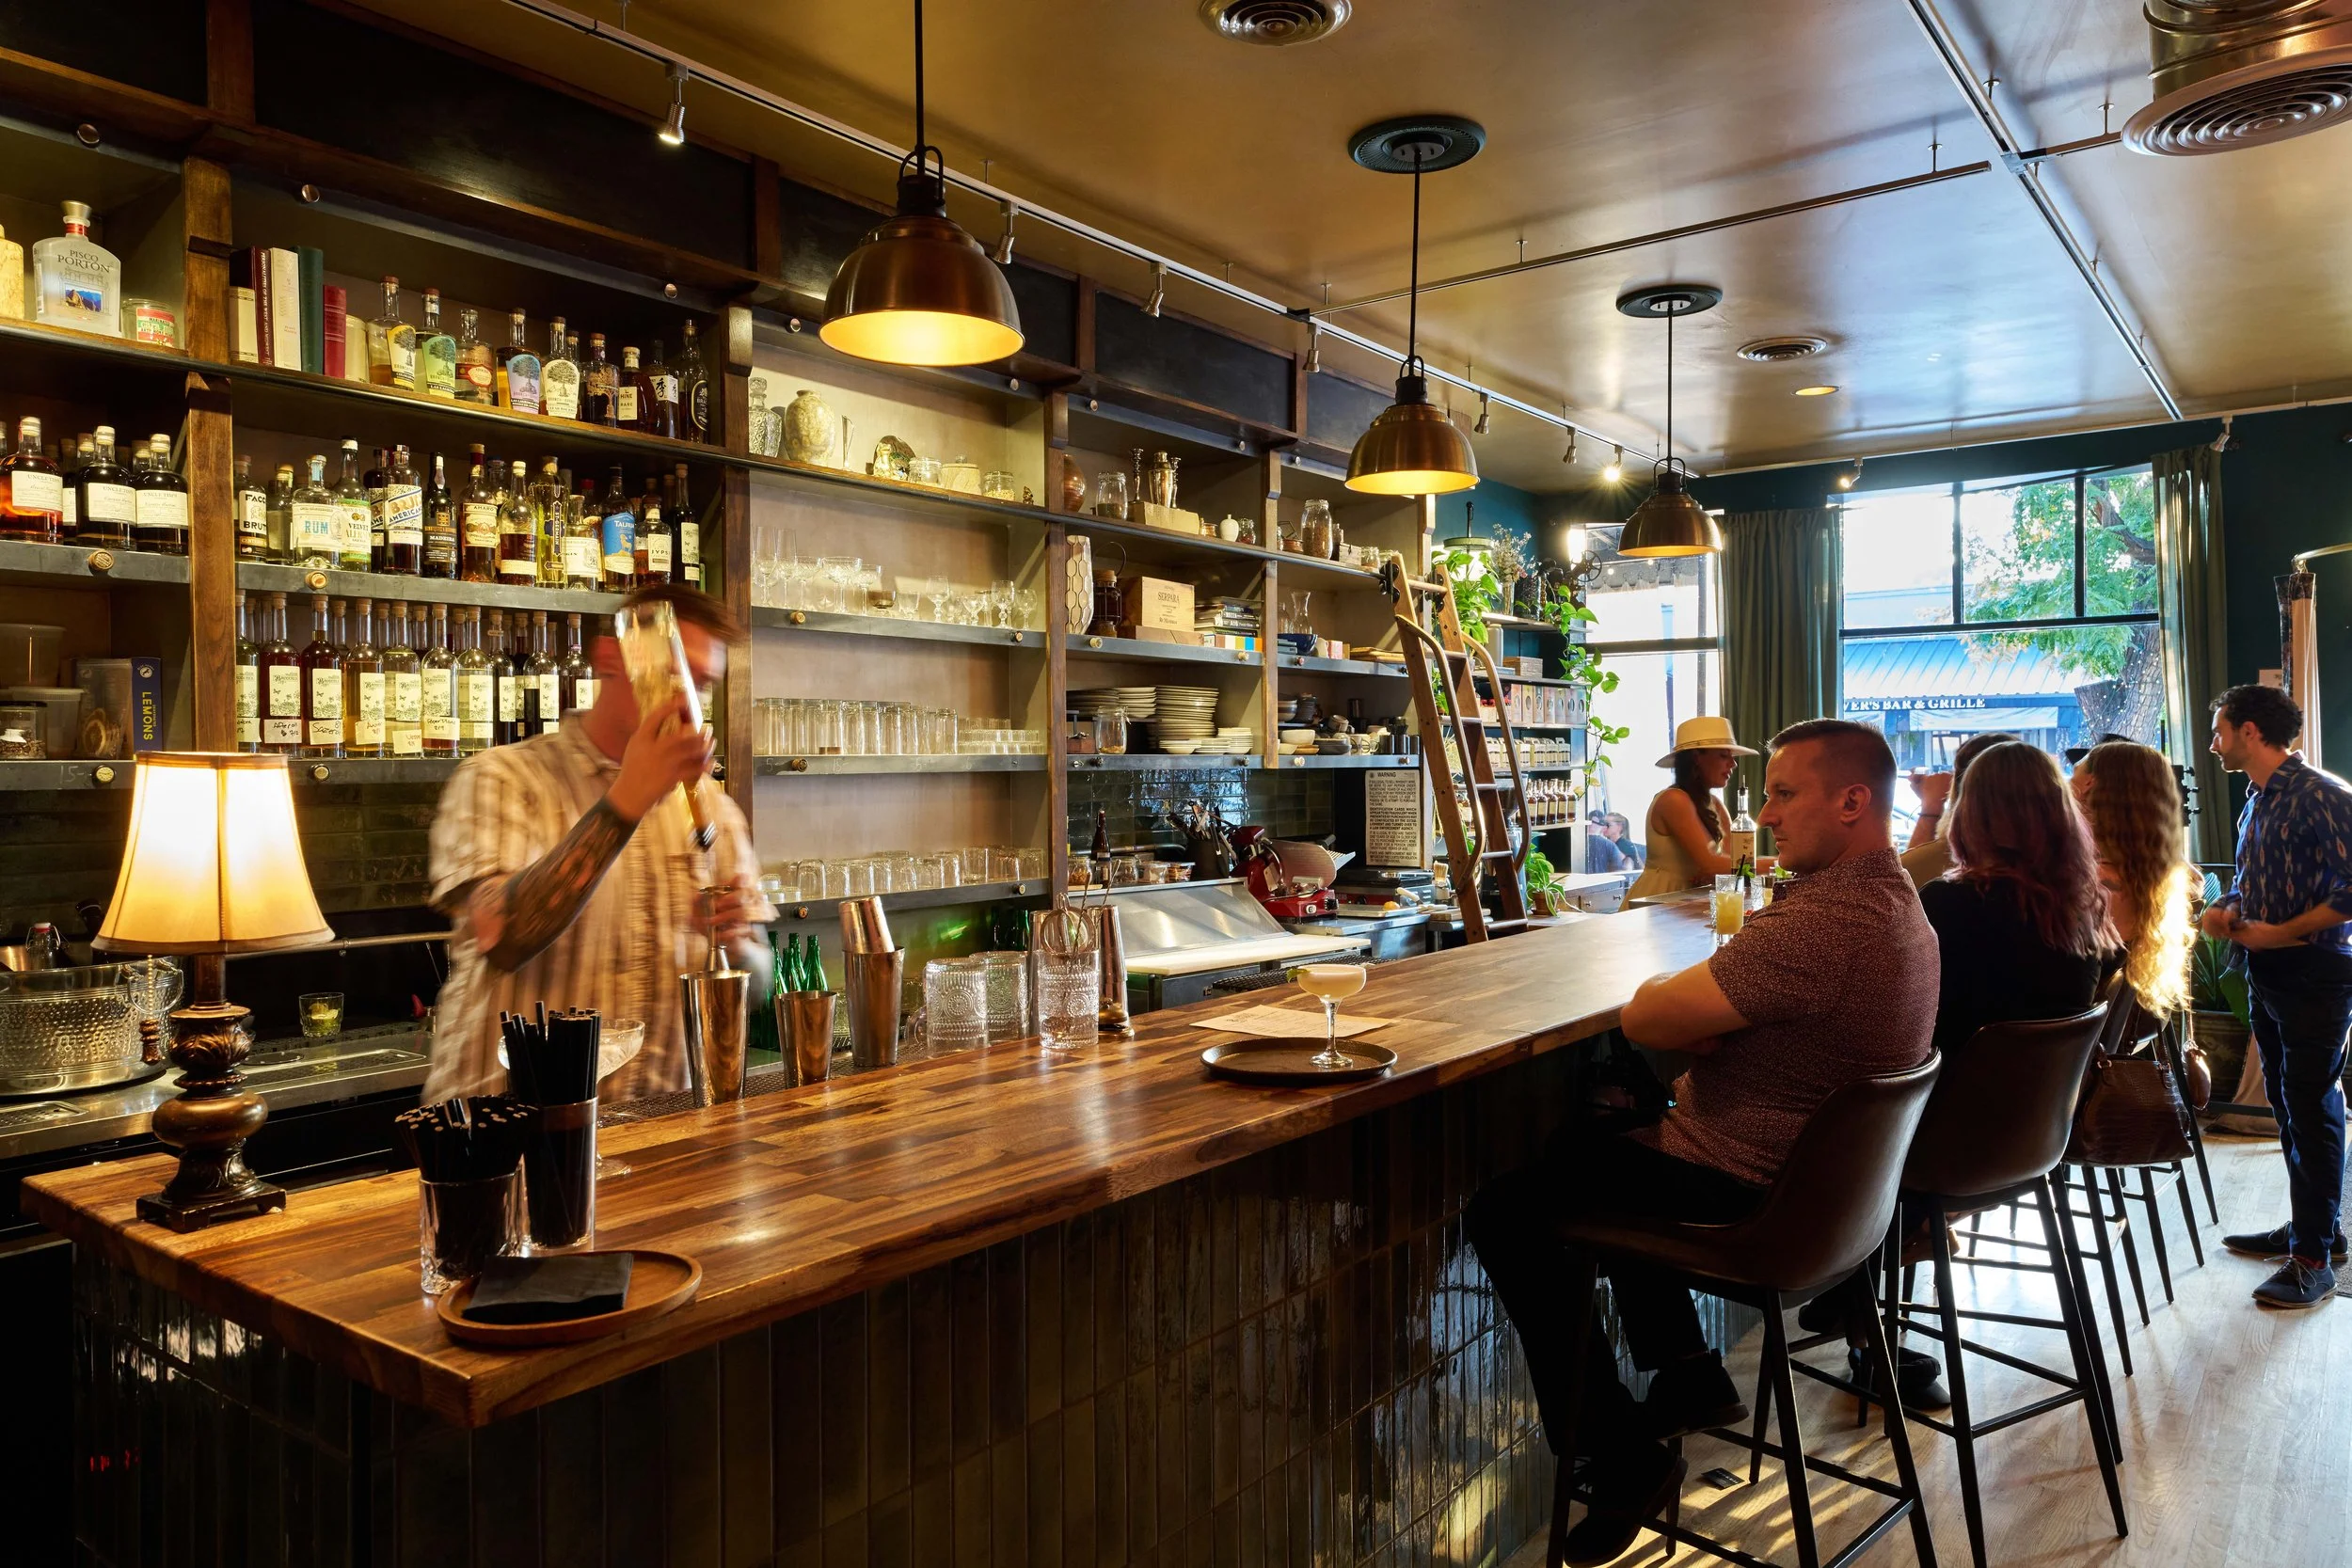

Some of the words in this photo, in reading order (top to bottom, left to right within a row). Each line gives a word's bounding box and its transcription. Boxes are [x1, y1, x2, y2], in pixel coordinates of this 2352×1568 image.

[70, 249, 99, 262] PISCO
[304, 520, 328, 534] RUM
[1883, 700, 1913, 710] BAR
[1914, 700, 1926, 709] &
[1928, 698, 1986, 709] GRILLE
[142, 691, 153, 740] LEMONS
